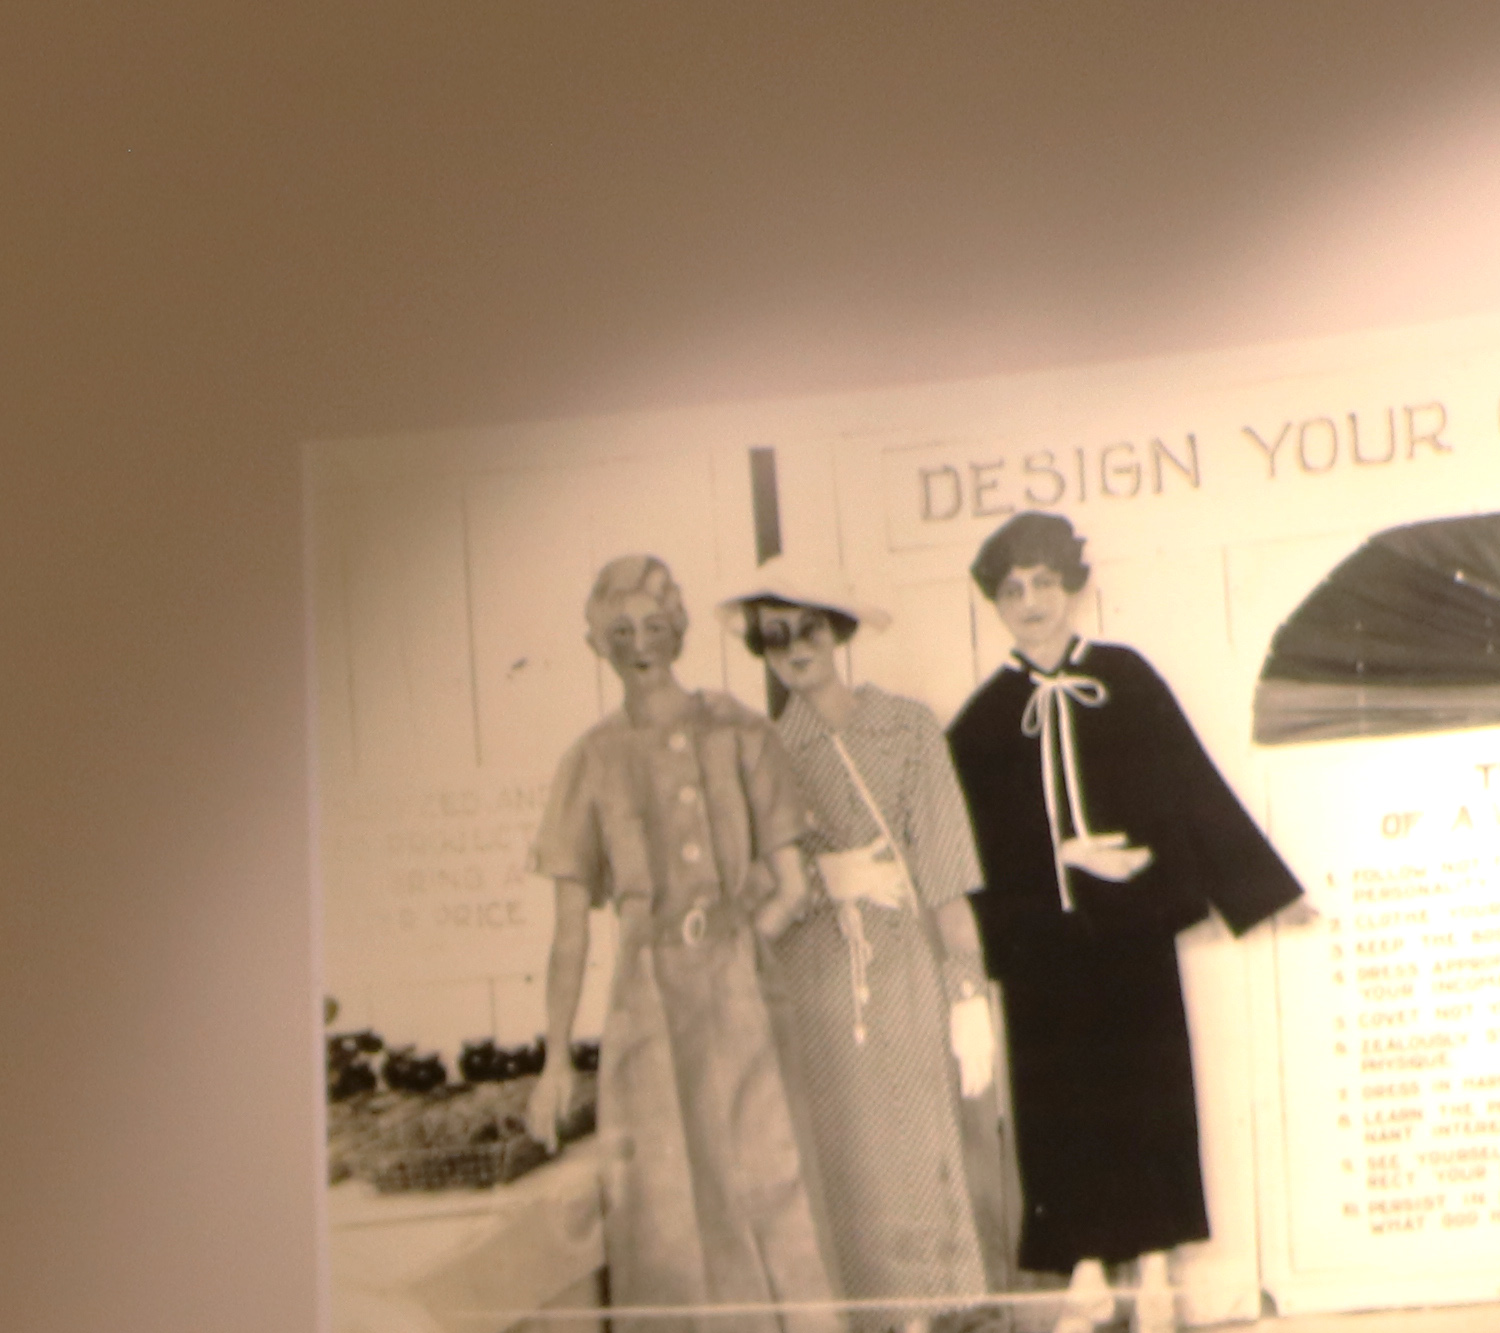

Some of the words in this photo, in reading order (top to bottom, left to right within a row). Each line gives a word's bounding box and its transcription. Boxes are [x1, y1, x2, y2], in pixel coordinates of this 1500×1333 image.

[917, 428, 1205, 527] DESIGN
[1243, 397, 1454, 483] YOUR
[1381, 810, 1424, 840] OF
[1451, 804, 1474, 833] A
[1352, 861, 1425, 885] FOLLOW
[1442, 856, 1478, 876] NOT
[1356, 908, 1427, 931] CLOTHE
[1356, 937, 1403, 957] KEEP
[1422, 931, 1453, 949] THE
[1357, 961, 1417, 983] DRESS
[1362, 982, 1412, 1003] YOUR
[1358, 1008, 1417, 1029] COVET
[1436, 1003, 1472, 1021] NOT
[1362, 1029, 1467, 1056] ZEALOUSLY
[1362, 1080, 1418, 1101] DRESS
[1434, 1077, 1449, 1094] IN
[1364, 1107, 1422, 1127] LEARN
[1440, 1102, 1470, 1120] THE
[1364, 1127, 1410, 1146] NANT
[1367, 1155, 1397, 1172] SEE
[1367, 1172, 1413, 1191] RECT
[1437, 1165, 1485, 1184] YOUR
[1368, 1195, 1446, 1218] PERSIST
[1461, 1191, 1485, 1209] IN
[1370, 1216, 1423, 1237] WHAT
[1441, 1211, 1477, 1230] GOD
